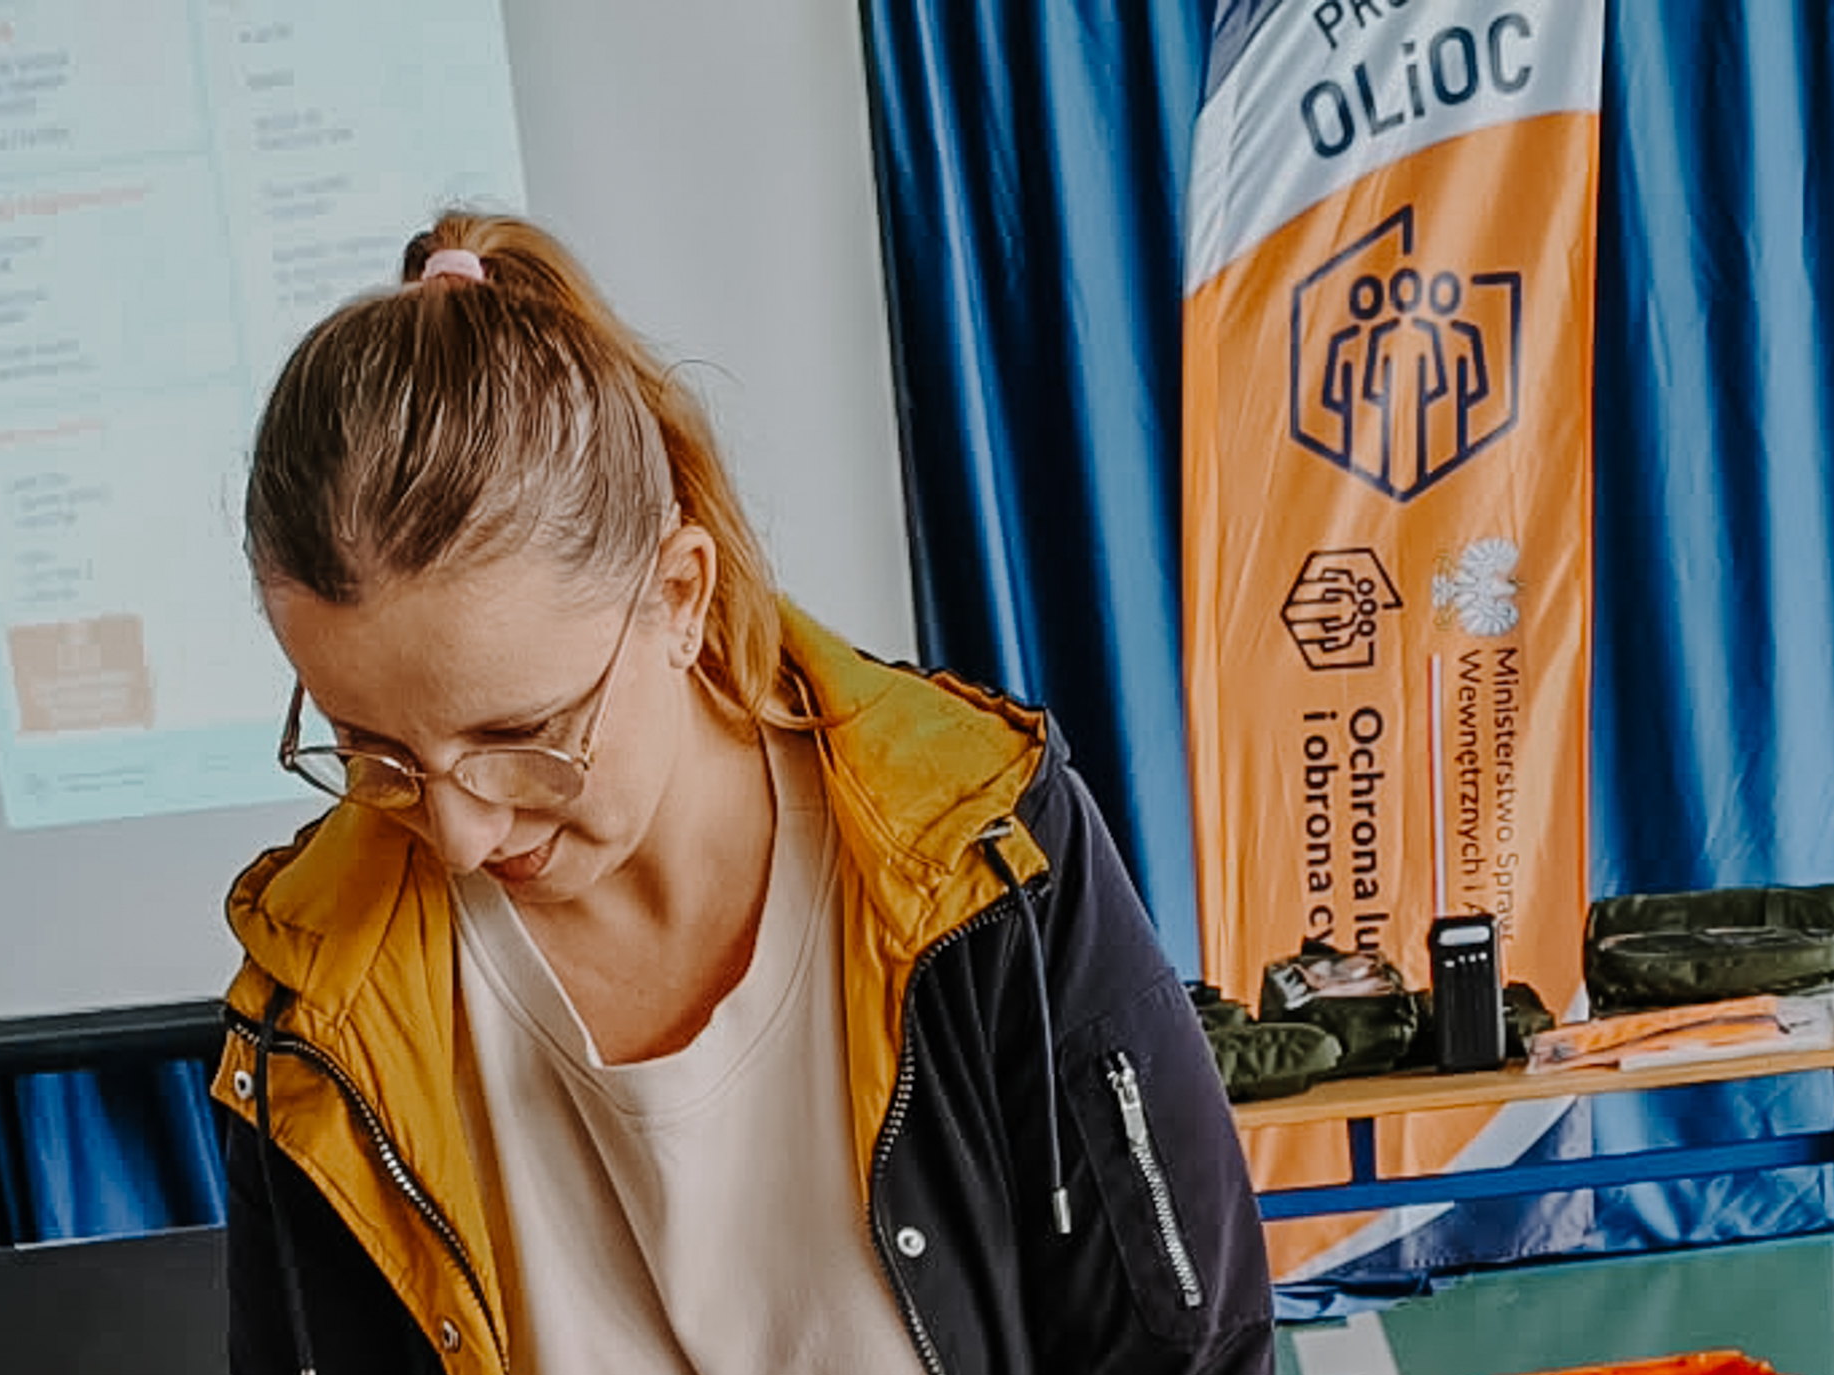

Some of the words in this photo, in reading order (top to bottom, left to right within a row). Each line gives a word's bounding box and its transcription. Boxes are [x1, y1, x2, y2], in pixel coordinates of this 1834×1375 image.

[1303, 709, 1338, 721] i
[1348, 706, 1385, 900] Ochrona
[1455, 649, 1486, 875] Wewnętrznych
[1492, 647, 1520, 843] Ministerstwo
[1302, 735, 1339, 894] obrona
